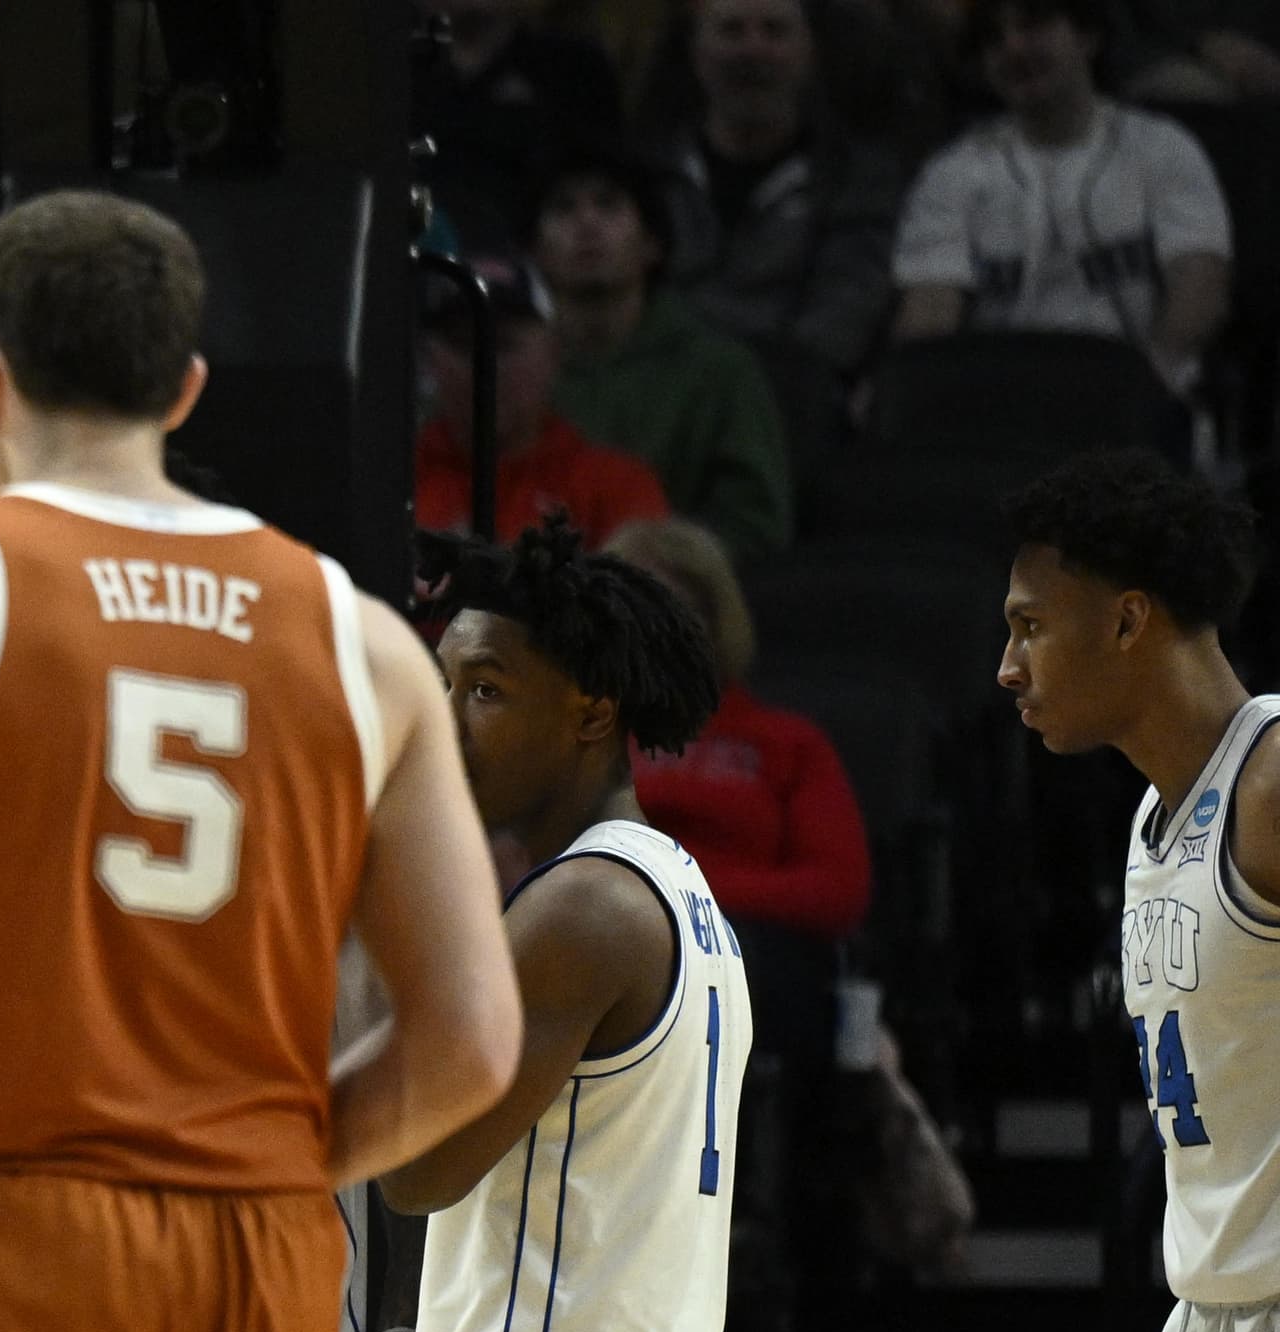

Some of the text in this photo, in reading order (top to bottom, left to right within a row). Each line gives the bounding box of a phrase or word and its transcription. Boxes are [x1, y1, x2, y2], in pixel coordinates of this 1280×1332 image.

[84, 558, 261, 643] HEIDE
[94, 665, 248, 925] 5
[699, 986, 720, 1196] 1
